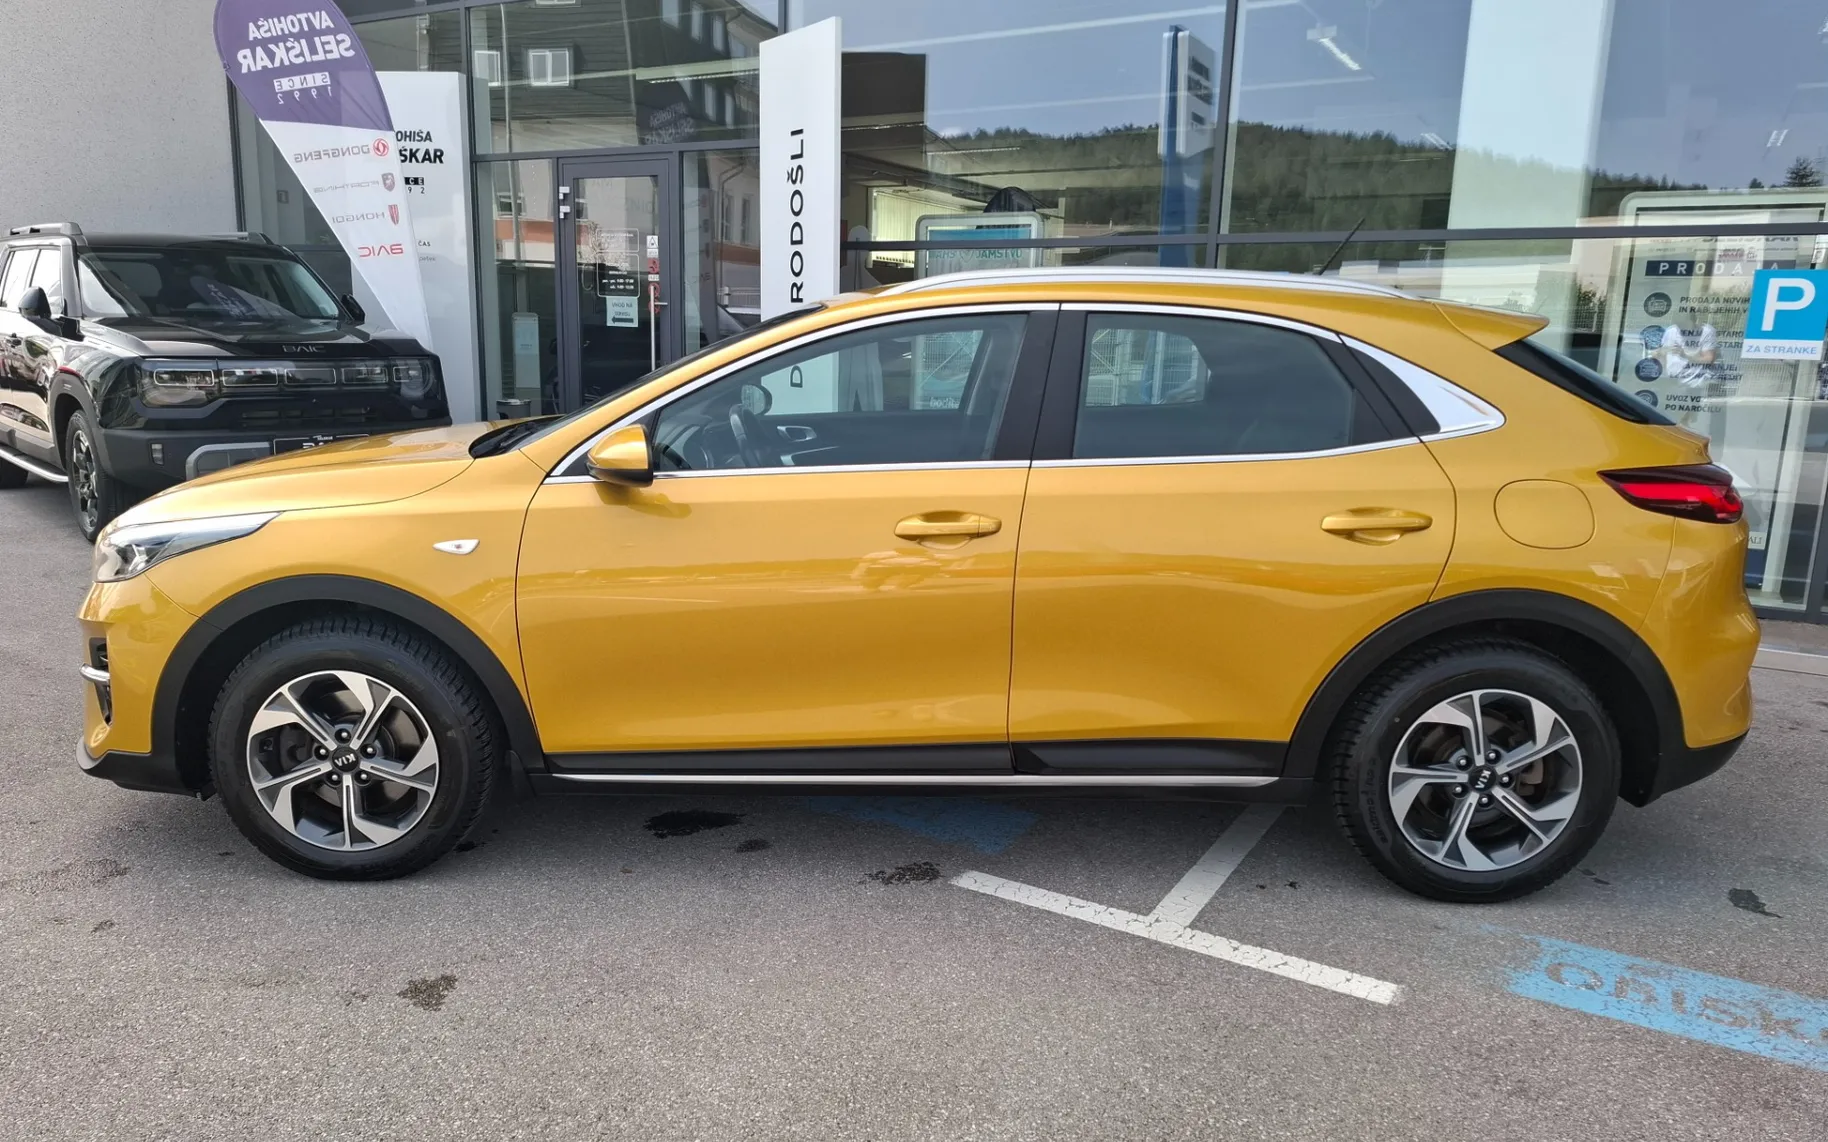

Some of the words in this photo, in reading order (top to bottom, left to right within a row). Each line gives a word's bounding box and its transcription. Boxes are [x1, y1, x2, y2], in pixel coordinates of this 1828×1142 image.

[396, 129, 432, 143] OHIŠA
[399, 146, 444, 164] ŠKAR
[1761, 278, 1816, 332] P
[1746, 345, 1761, 353] ZA
[1764, 345, 1817, 355] STRANKE
